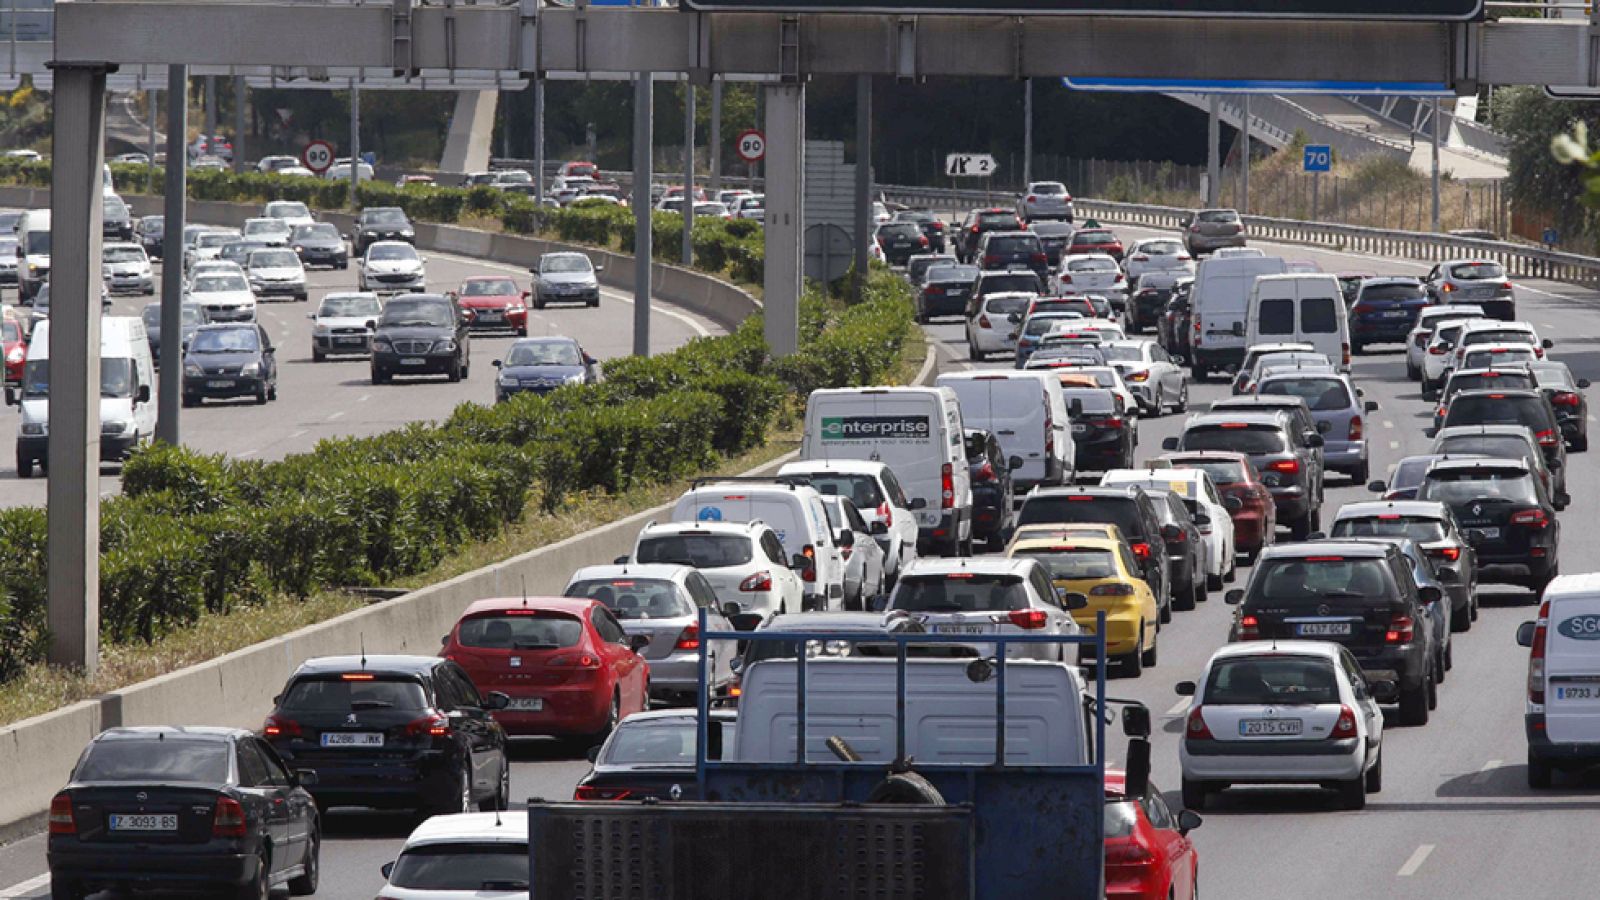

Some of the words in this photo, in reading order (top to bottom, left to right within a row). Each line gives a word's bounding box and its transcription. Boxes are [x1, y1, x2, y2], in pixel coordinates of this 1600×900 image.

[742, 140, 761, 152] 90
[309, 151, 328, 162] 90
[1307, 152, 1328, 166] 70
[979, 159, 989, 171] 2
[827, 420, 928, 435] enterprise
[1571, 617, 1600, 633] SG
[1565, 687, 1590, 698] 9733
[1247, 722, 1275, 732] 2015
[1278, 722, 1299, 732] CVH
